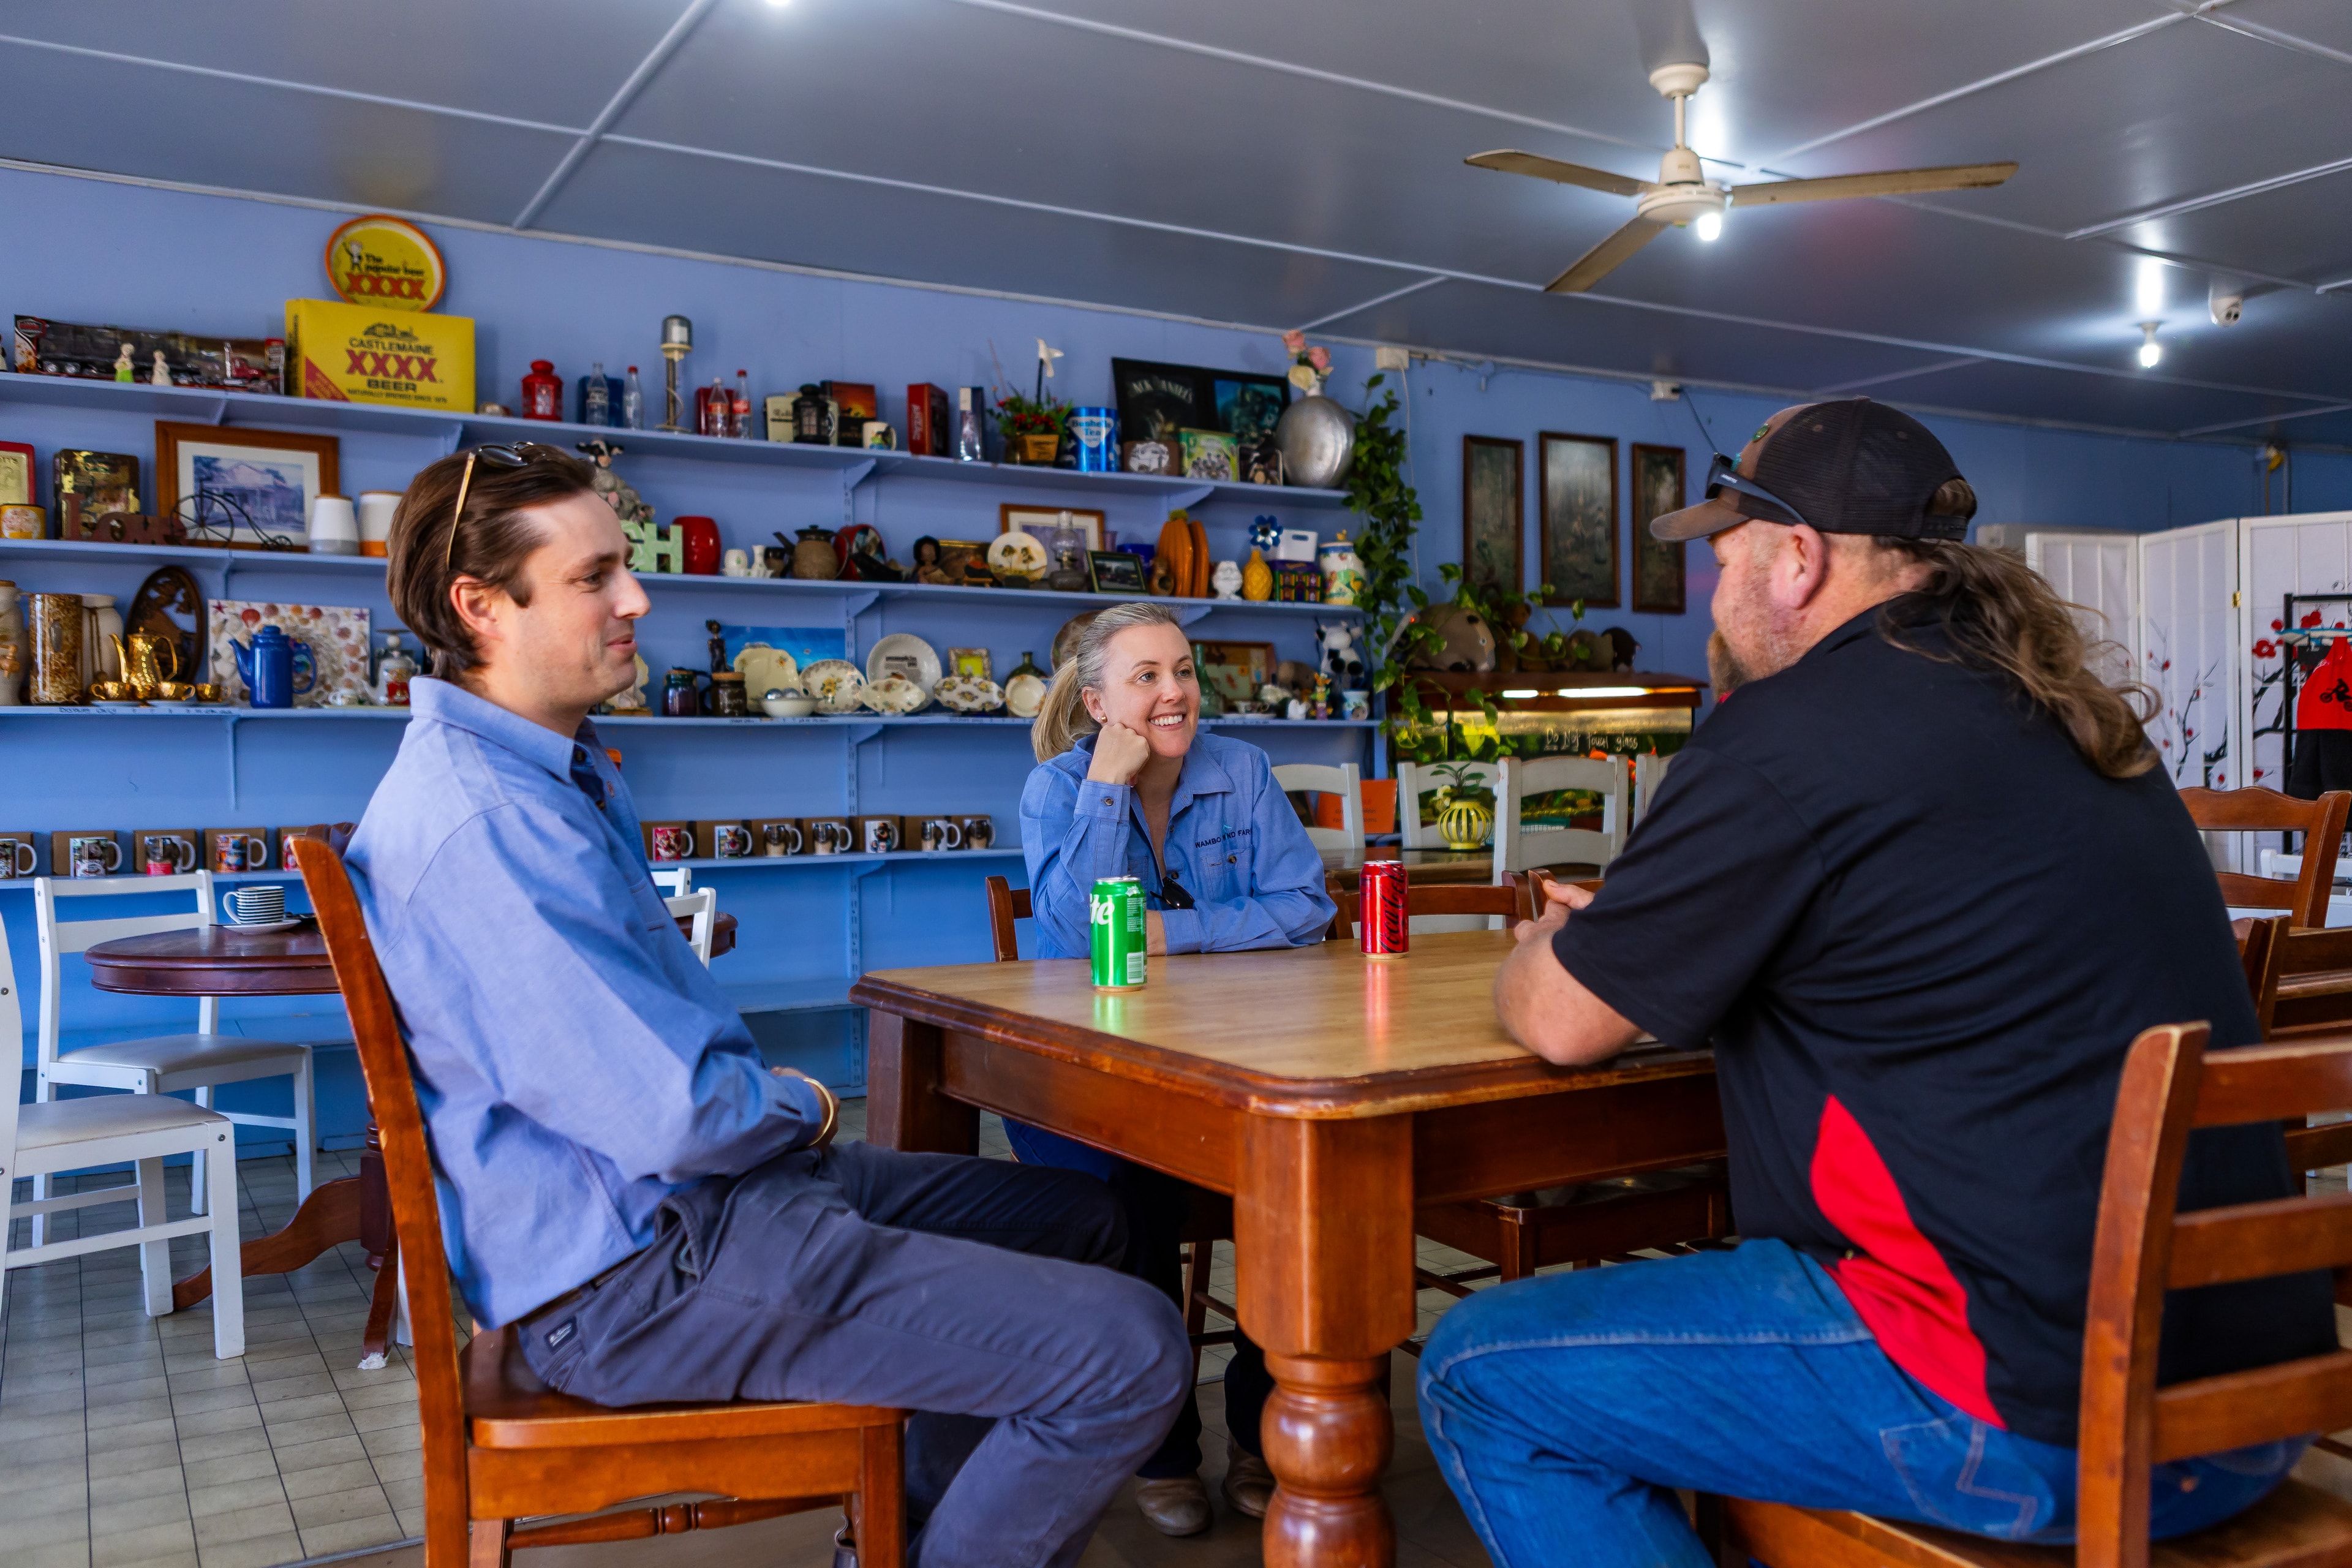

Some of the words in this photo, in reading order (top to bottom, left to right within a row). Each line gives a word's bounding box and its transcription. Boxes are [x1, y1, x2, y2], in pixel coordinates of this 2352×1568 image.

[346, 273, 426, 300] XXXX
[349, 337, 434, 355] CASTLEMAINE
[345, 349, 437, 383] XXXX
[368, 379, 417, 392] BEER
[1194, 837, 1222, 849] WAMBO
[1222, 831, 1236, 842] WND
